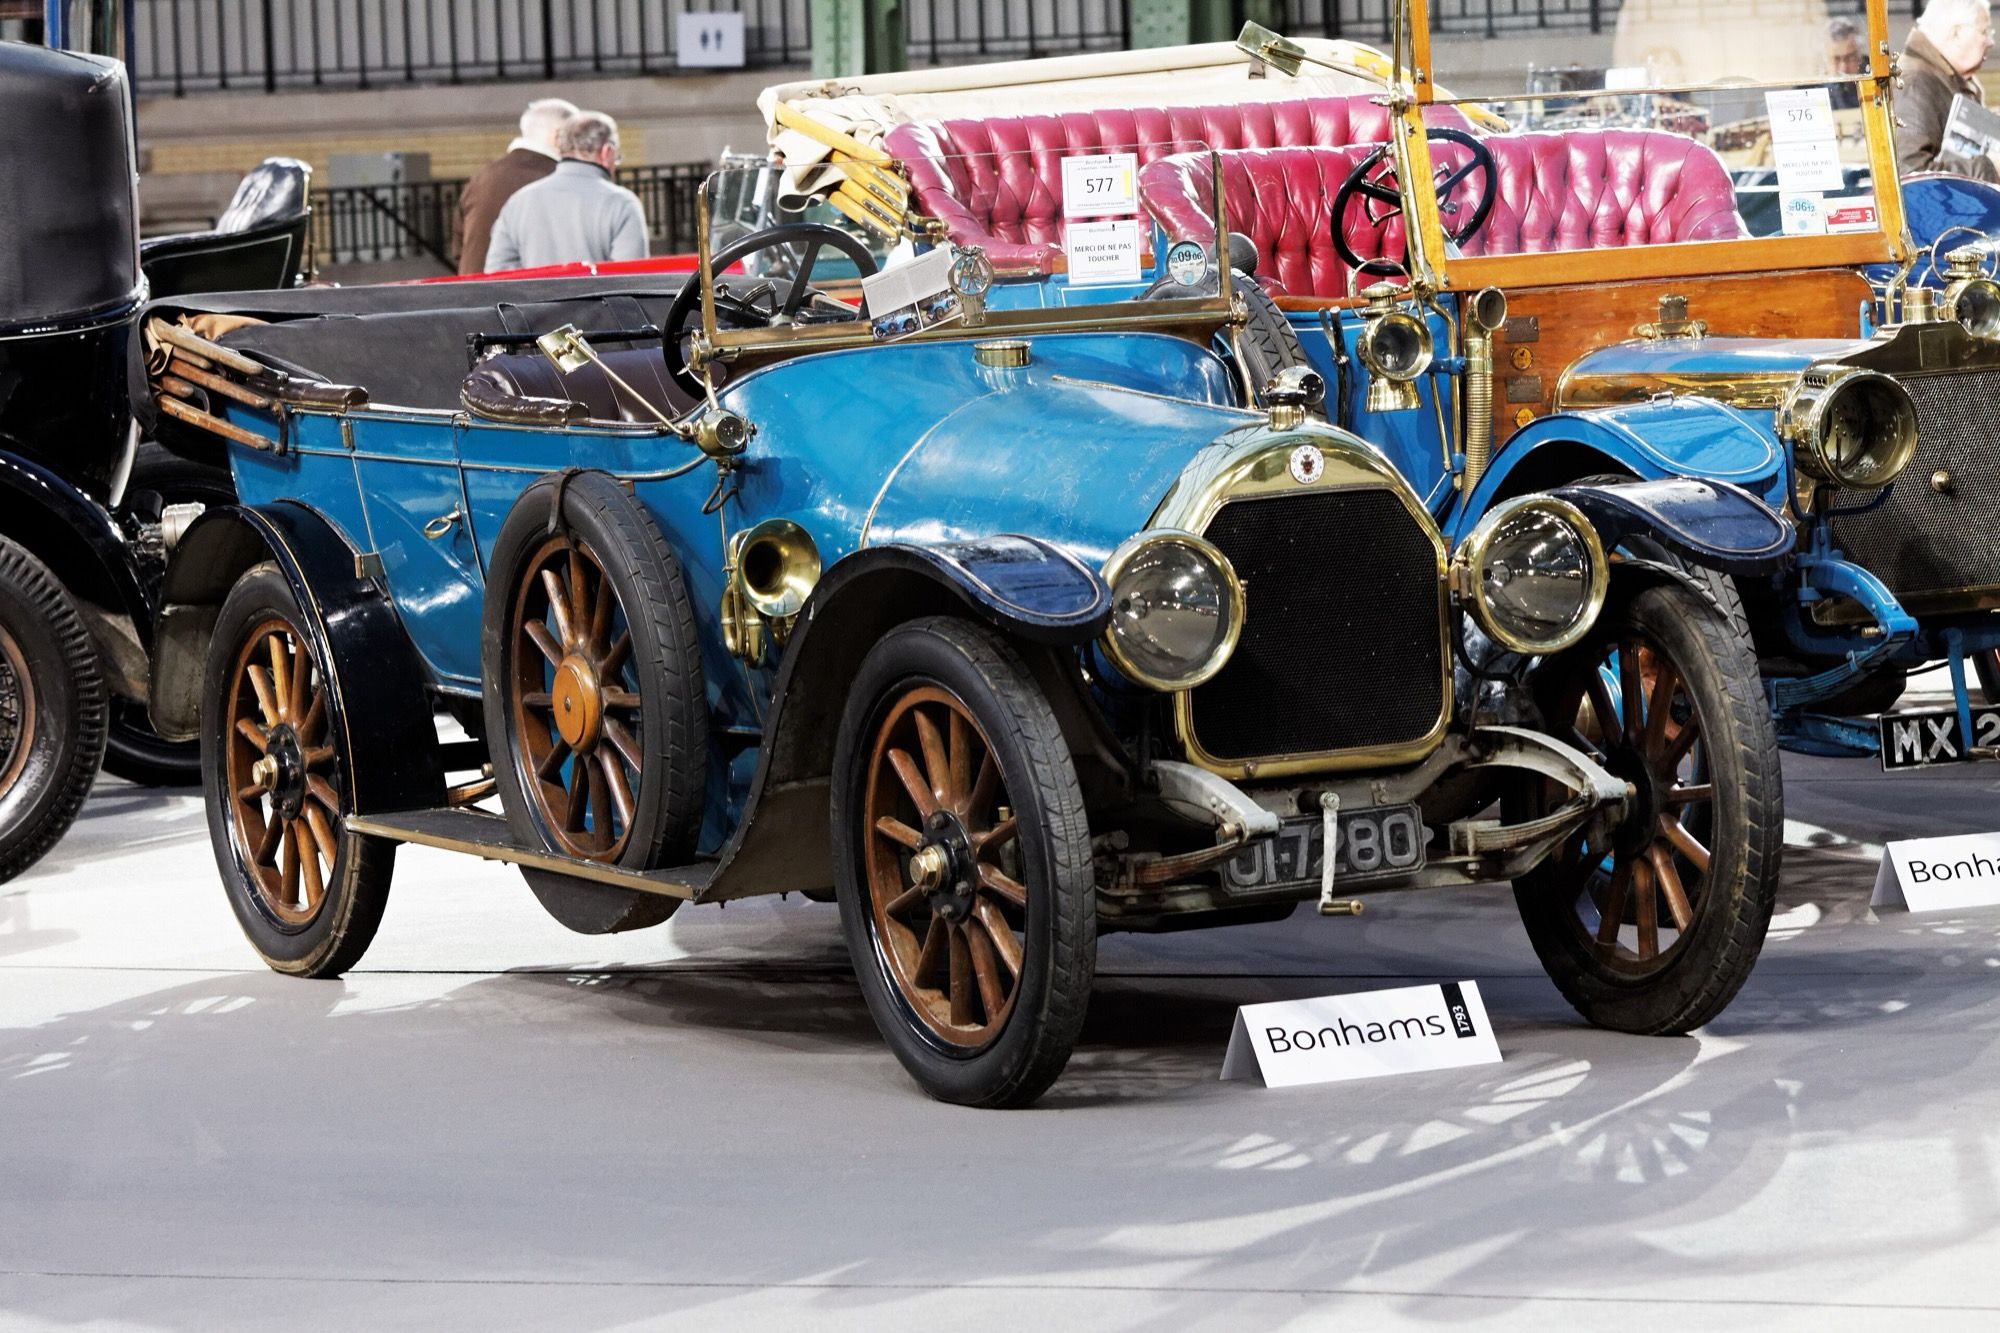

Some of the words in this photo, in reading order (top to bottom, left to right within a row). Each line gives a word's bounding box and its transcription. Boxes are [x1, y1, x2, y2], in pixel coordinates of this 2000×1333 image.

[1787, 108, 1813, 122] 576
[1086, 177, 1113, 193] 577
[1865, 209, 1874, 222] 3
[1074, 245, 1096, 253] MERCI
[1107, 243, 1117, 251] NE
[1118, 242, 1132, 250] PAS
[1088, 254, 1120, 262] TOUCHER
[1177, 250, 1191, 262] 09
[1893, 716, 1957, 763] MX
[1908, 853, 2000, 883] Bonh
[1452, 1005, 1471, 1033] 1793
[1265, 1015, 1446, 1054] Bonhams
